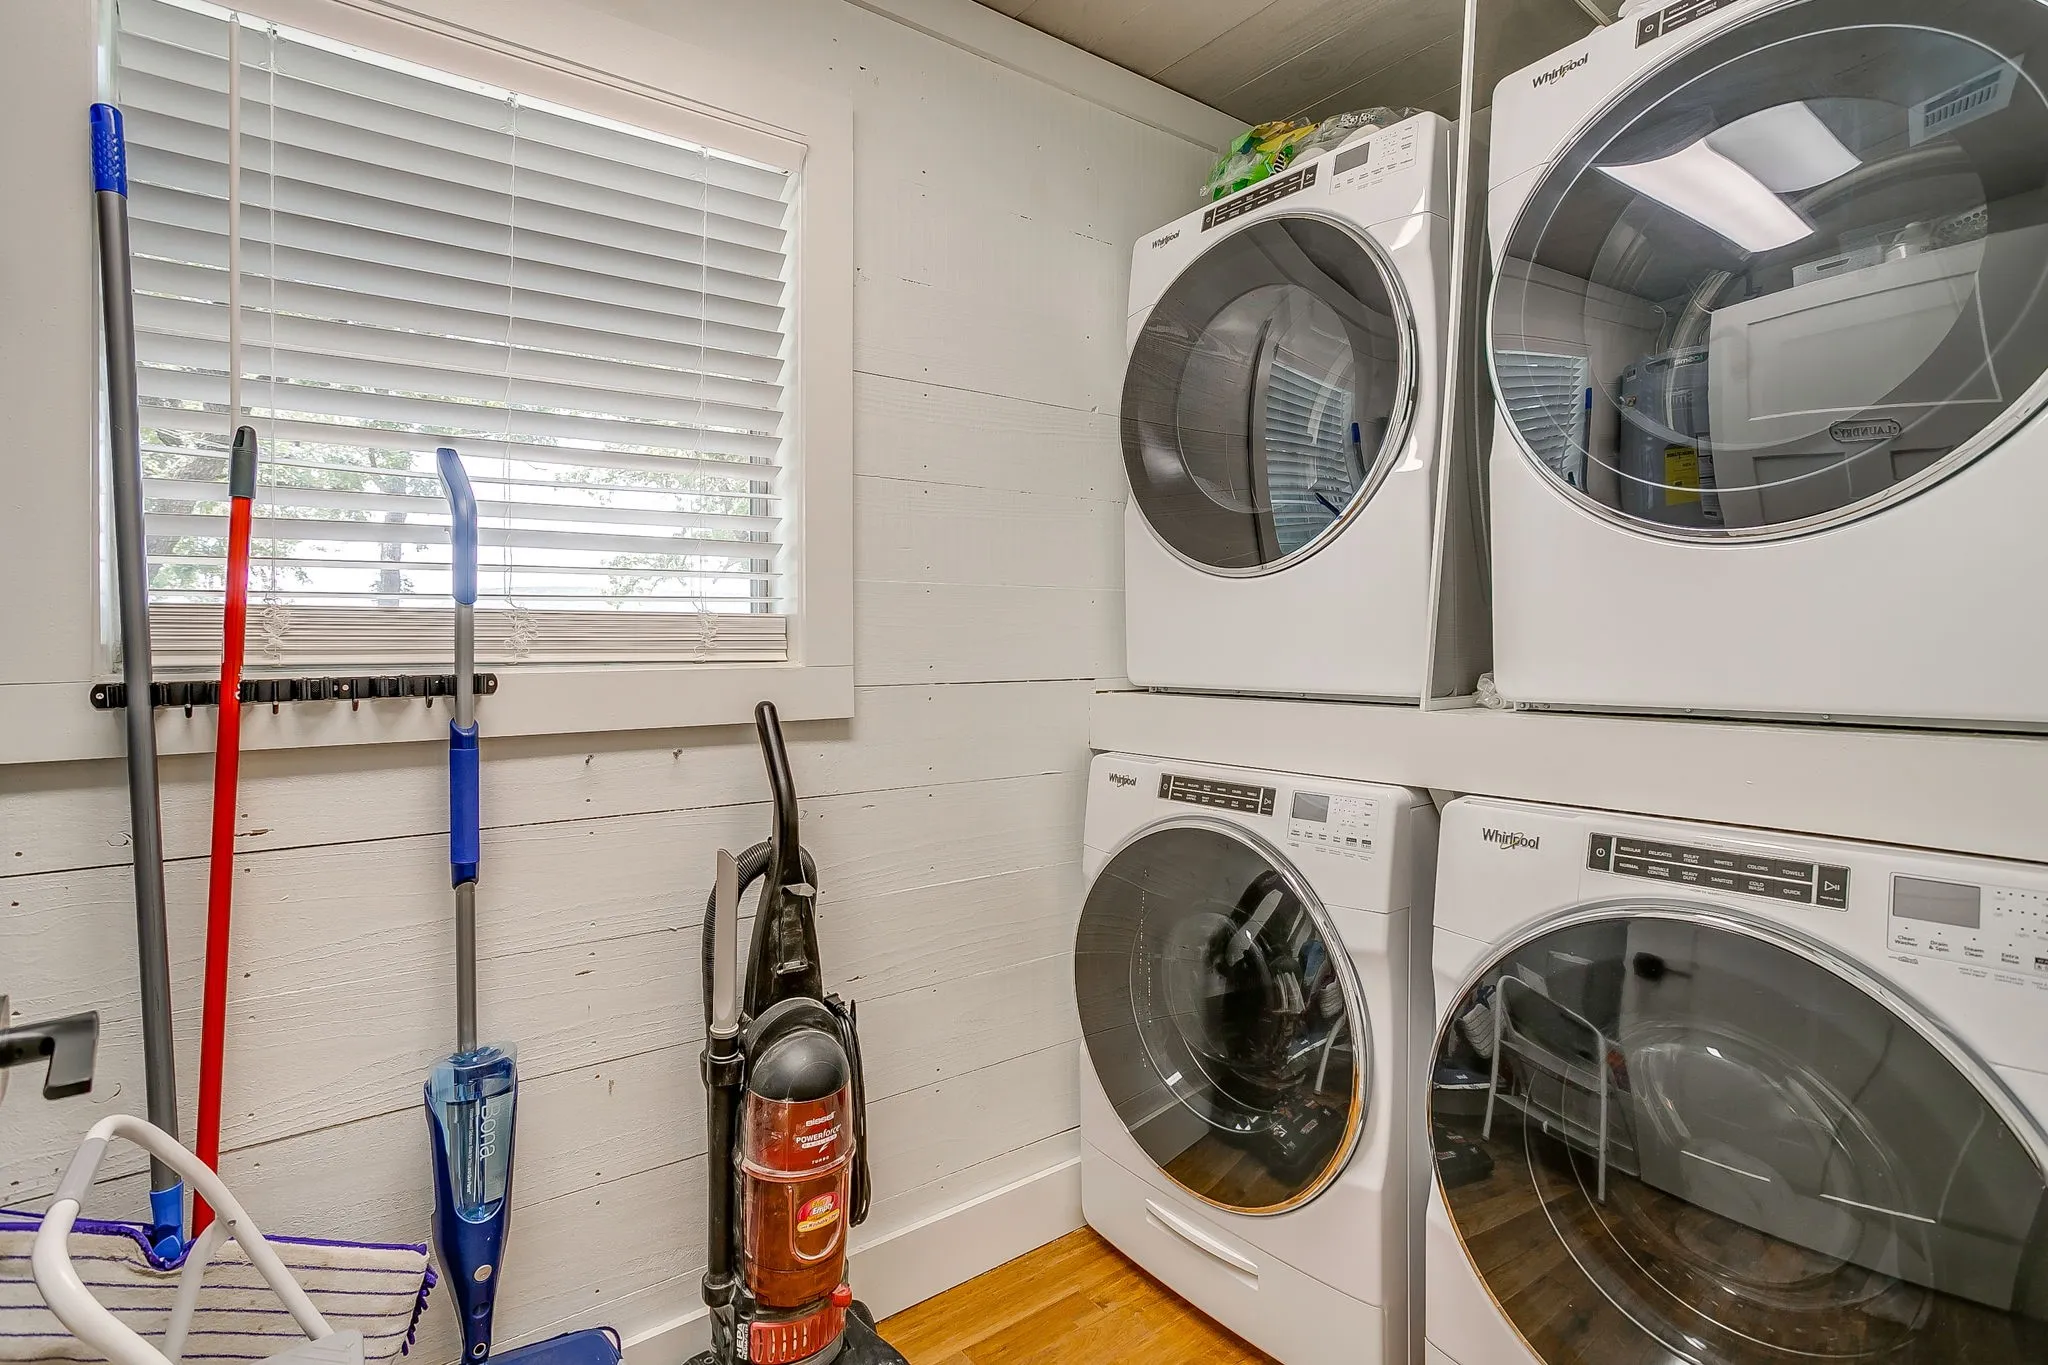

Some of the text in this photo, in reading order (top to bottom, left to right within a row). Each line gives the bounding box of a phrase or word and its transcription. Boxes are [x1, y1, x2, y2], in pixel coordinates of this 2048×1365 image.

[1532, 52, 1589, 88] Whirlpool
[1152, 230, 1180, 248] Whirlpool
[1109, 772, 1137, 787] Whirlpool
[1482, 827, 1540, 850] Whirlpool
[1648, 850, 1673, 858] DELICATES
[1619, 862, 1639, 870] NORMAL
[1713, 859, 1733, 867] WHITES
[1747, 864, 1768, 872] COLORS
[1782, 869, 1805, 877] TOWELS
[1783, 888, 1801, 896] QUICK
[480, 1102, 501, 1161] Bona
[812, 1201, 834, 1215] Empty
